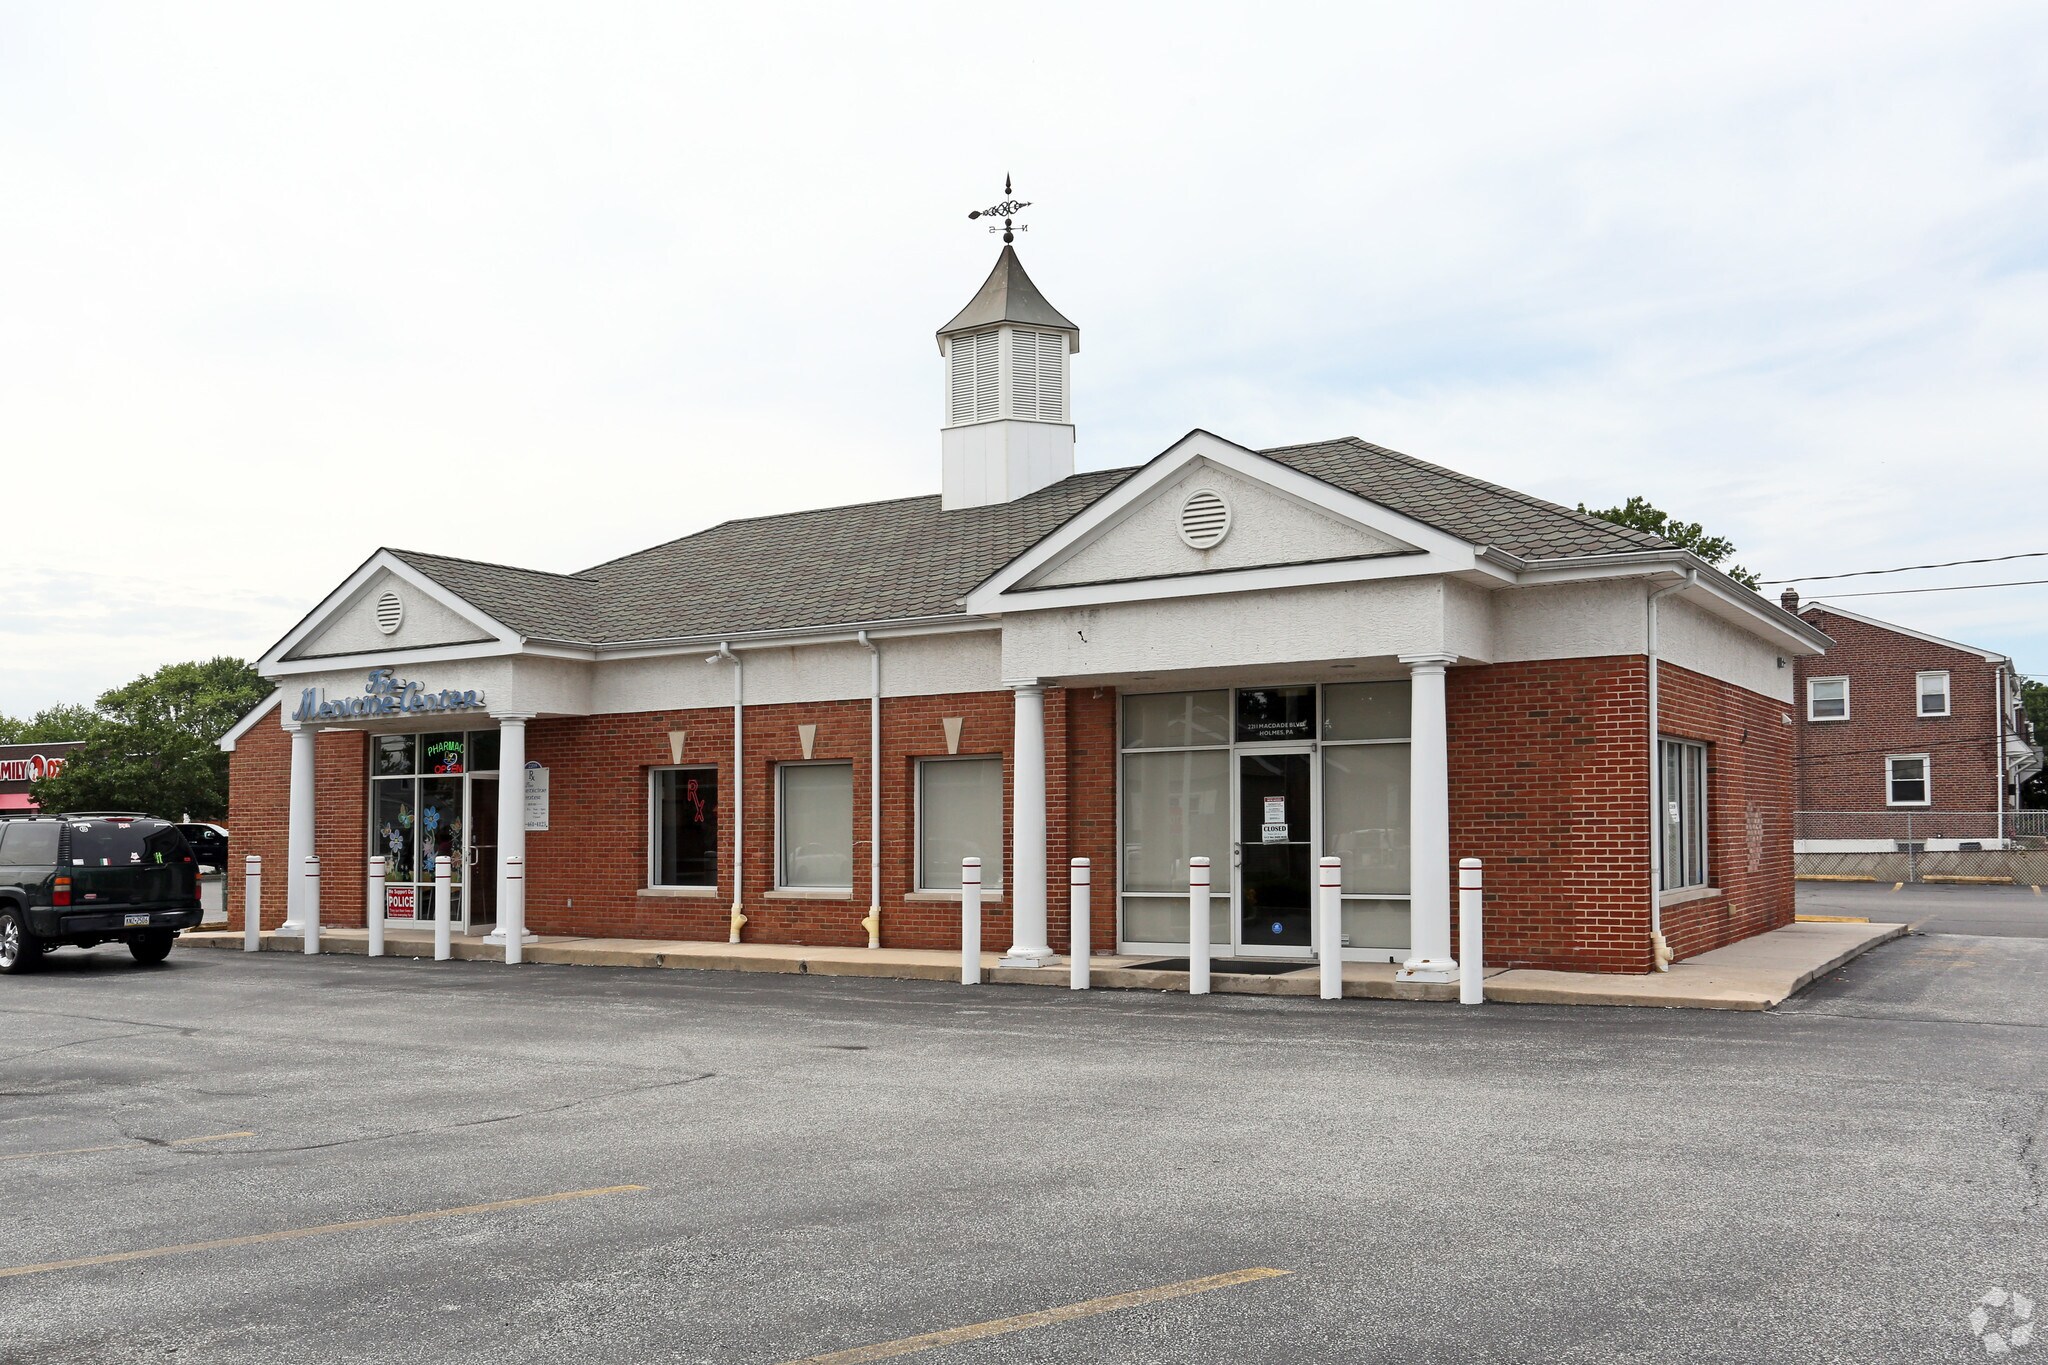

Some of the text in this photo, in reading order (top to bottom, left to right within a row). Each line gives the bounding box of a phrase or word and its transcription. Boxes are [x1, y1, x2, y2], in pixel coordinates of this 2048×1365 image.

[365, 669, 399, 695] The
[291, 681, 483, 722] Medicine Center
[0, 760, 29, 780] MILY
[388, 896, 414, 908] POLICE
